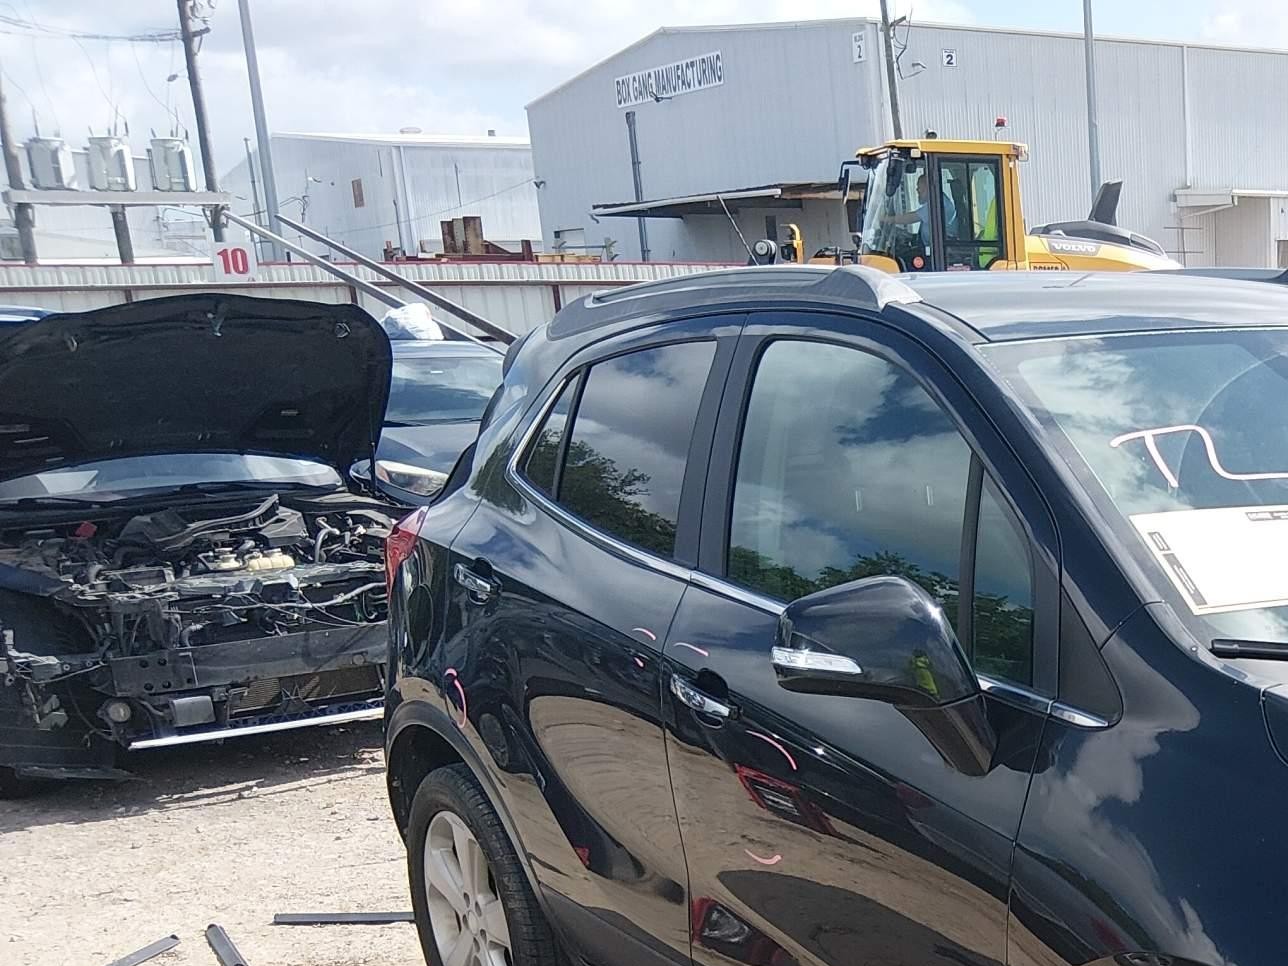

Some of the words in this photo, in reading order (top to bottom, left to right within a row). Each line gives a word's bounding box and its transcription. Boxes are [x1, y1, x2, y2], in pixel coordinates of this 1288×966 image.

[945, 53, 954, 65] 2
[616, 77, 632, 105] BOX
[632, 72, 654, 102] GANG
[654, 54, 722, 96] MANUFACTURING
[1052, 243, 1097, 252] VOLVO
[217, 248, 249, 275] 10
